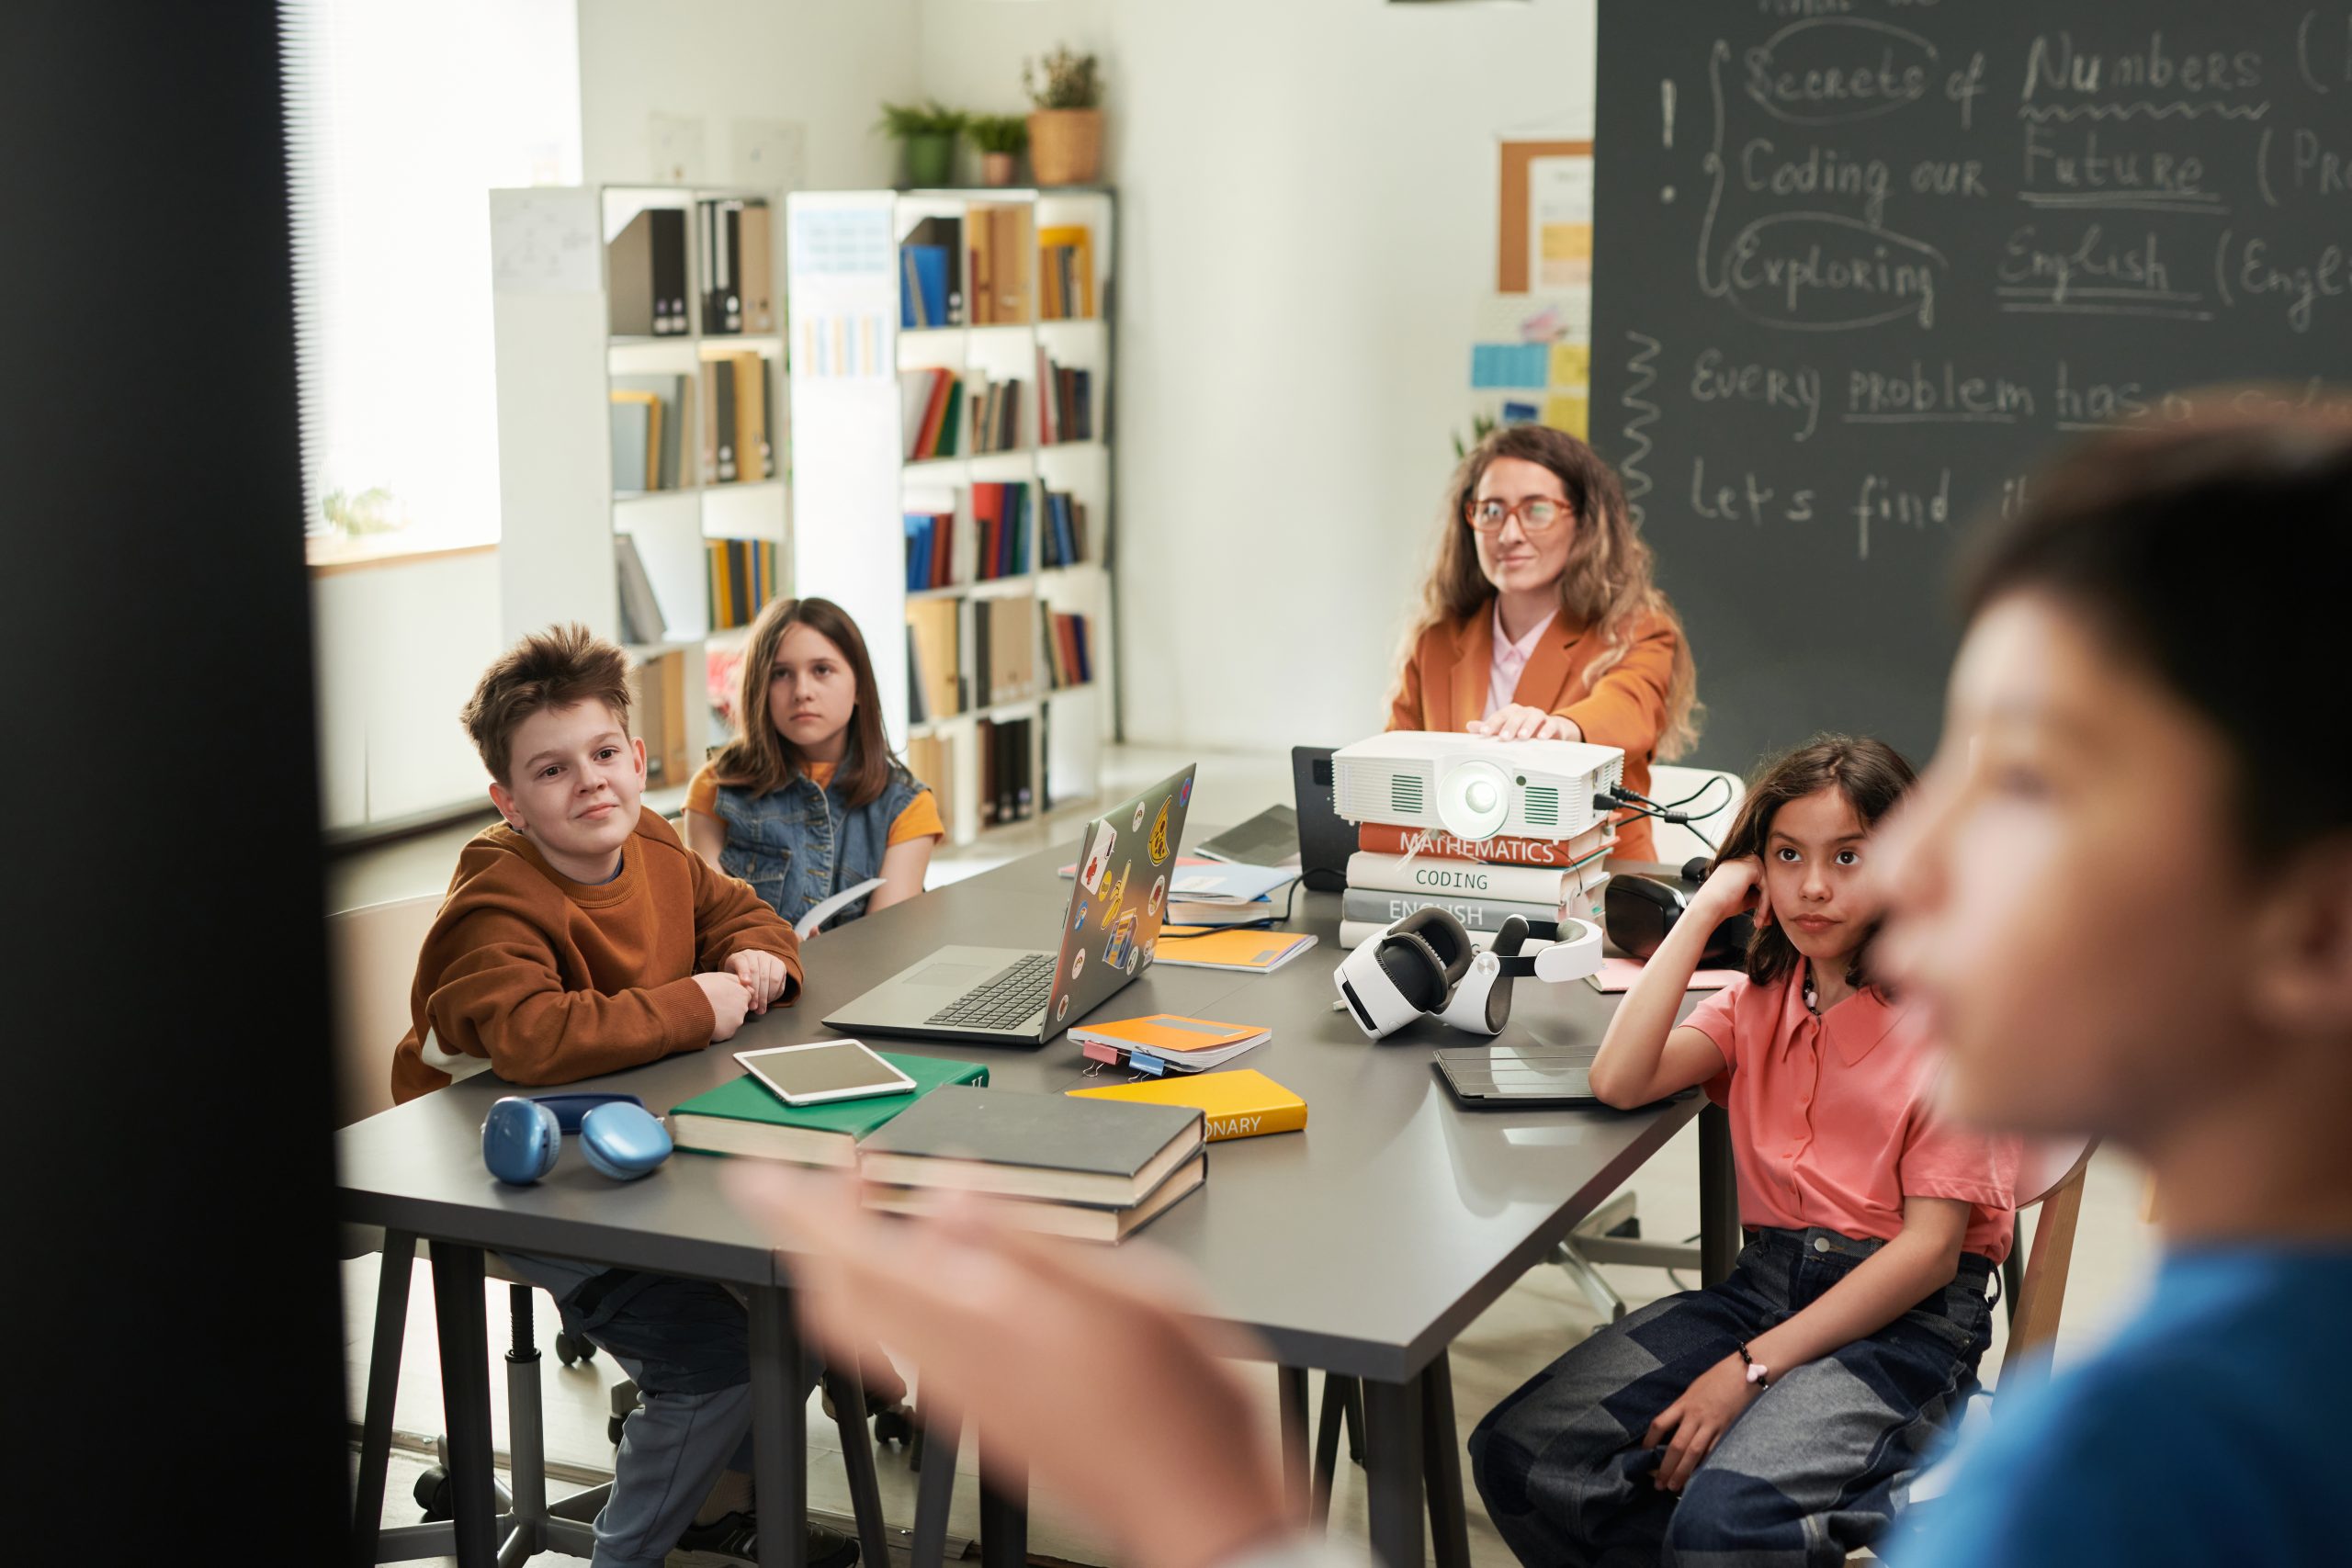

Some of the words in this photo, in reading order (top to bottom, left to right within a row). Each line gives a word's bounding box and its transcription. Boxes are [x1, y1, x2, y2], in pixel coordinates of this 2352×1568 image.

[1745, 46, 1927, 100] Secrets
[1945, 50, 1984, 130] of
[1742, 138, 1893, 228] Coding
[1997, 224, 2169, 303] English
[2055, 359, 2150, 421] has
[1850, 468, 1951, 560] find
[1400, 831, 1555, 863] MATHEMATICS
[1416, 869, 1487, 890] CODING
